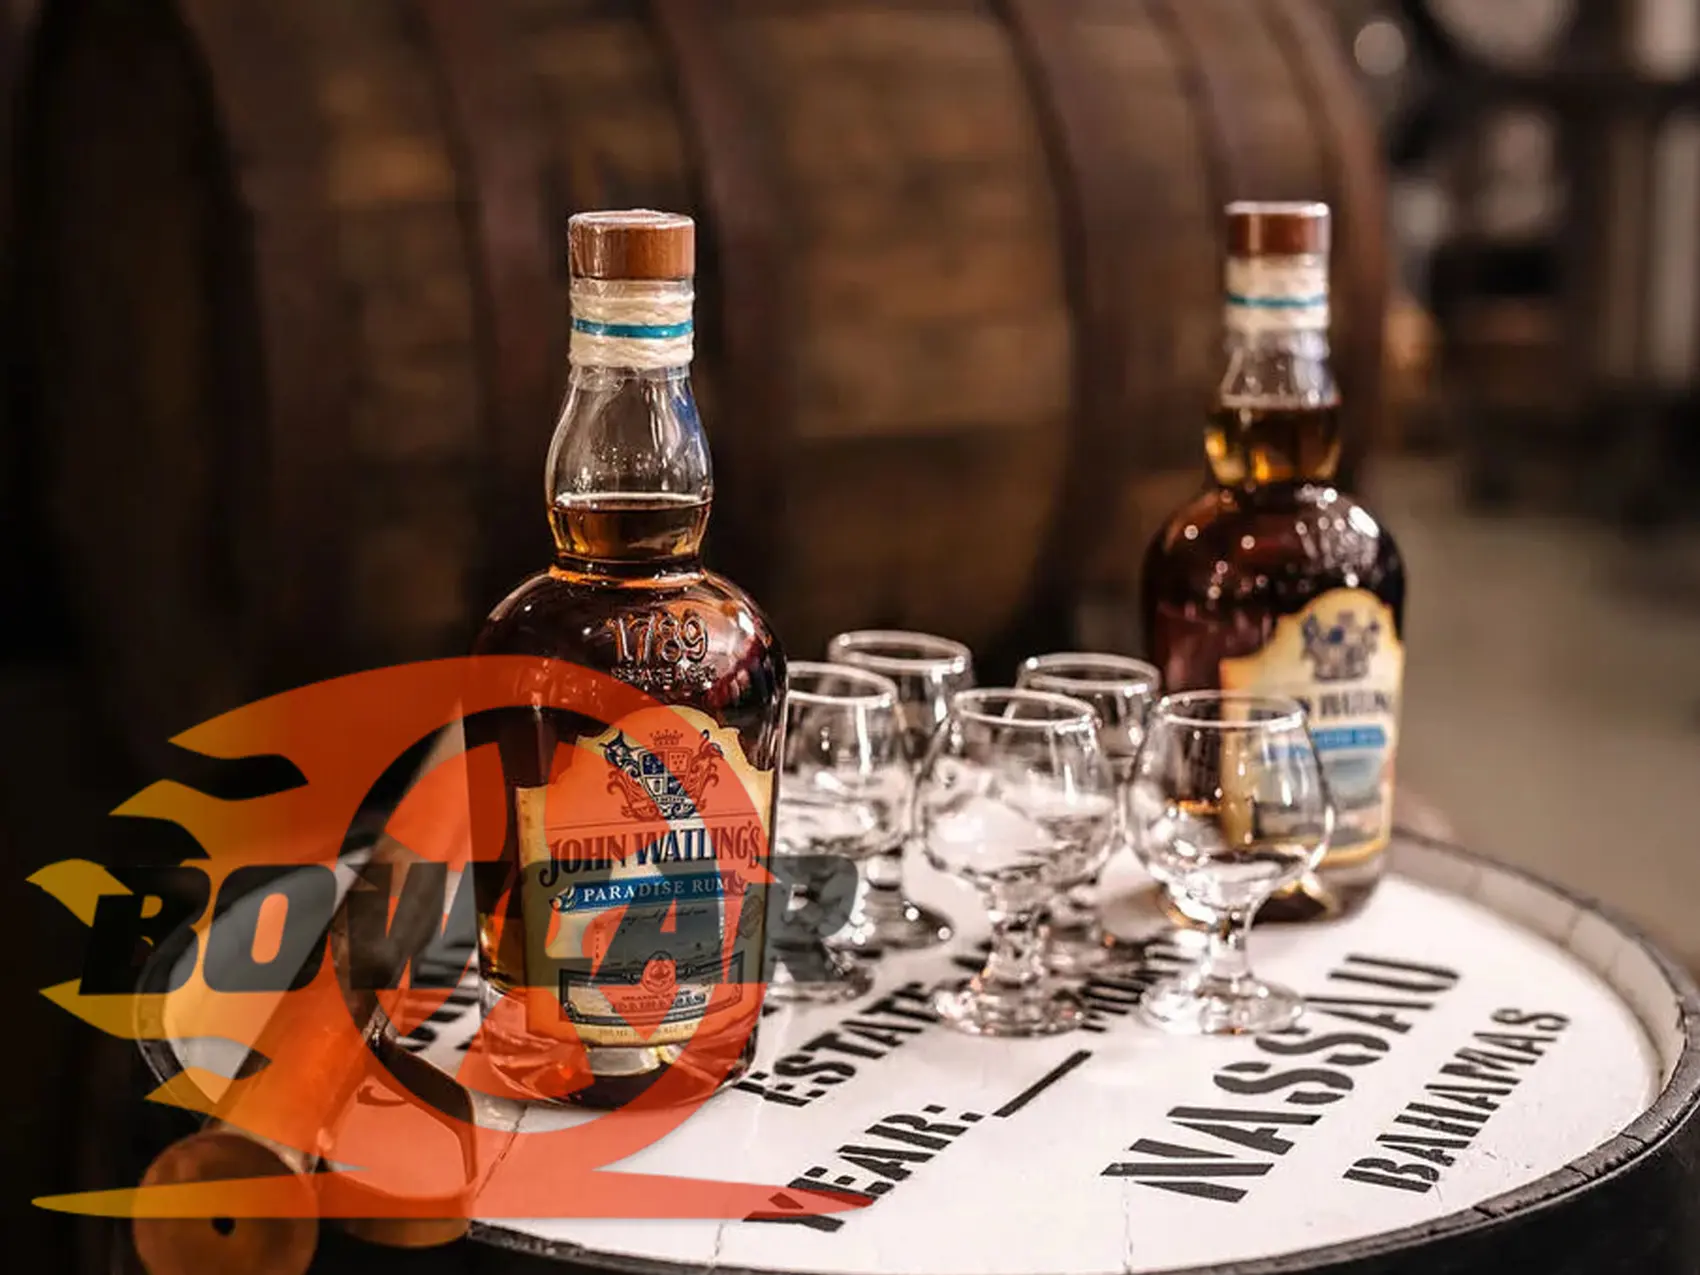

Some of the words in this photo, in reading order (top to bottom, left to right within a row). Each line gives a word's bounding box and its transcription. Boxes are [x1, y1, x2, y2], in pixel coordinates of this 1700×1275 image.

[604, 608, 710, 666] 1789
[538, 834, 628, 888] JOHN
[634, 823, 762, 871] WATLING'S
[583, 879, 687, 903] PARADISE
[691, 874, 730, 894] RUM
[1100, 953, 1461, 1203] NASSAU
[1341, 1007, 1571, 1194] BAHAMAS
[742, 1104, 985, 1233] YEAR:
